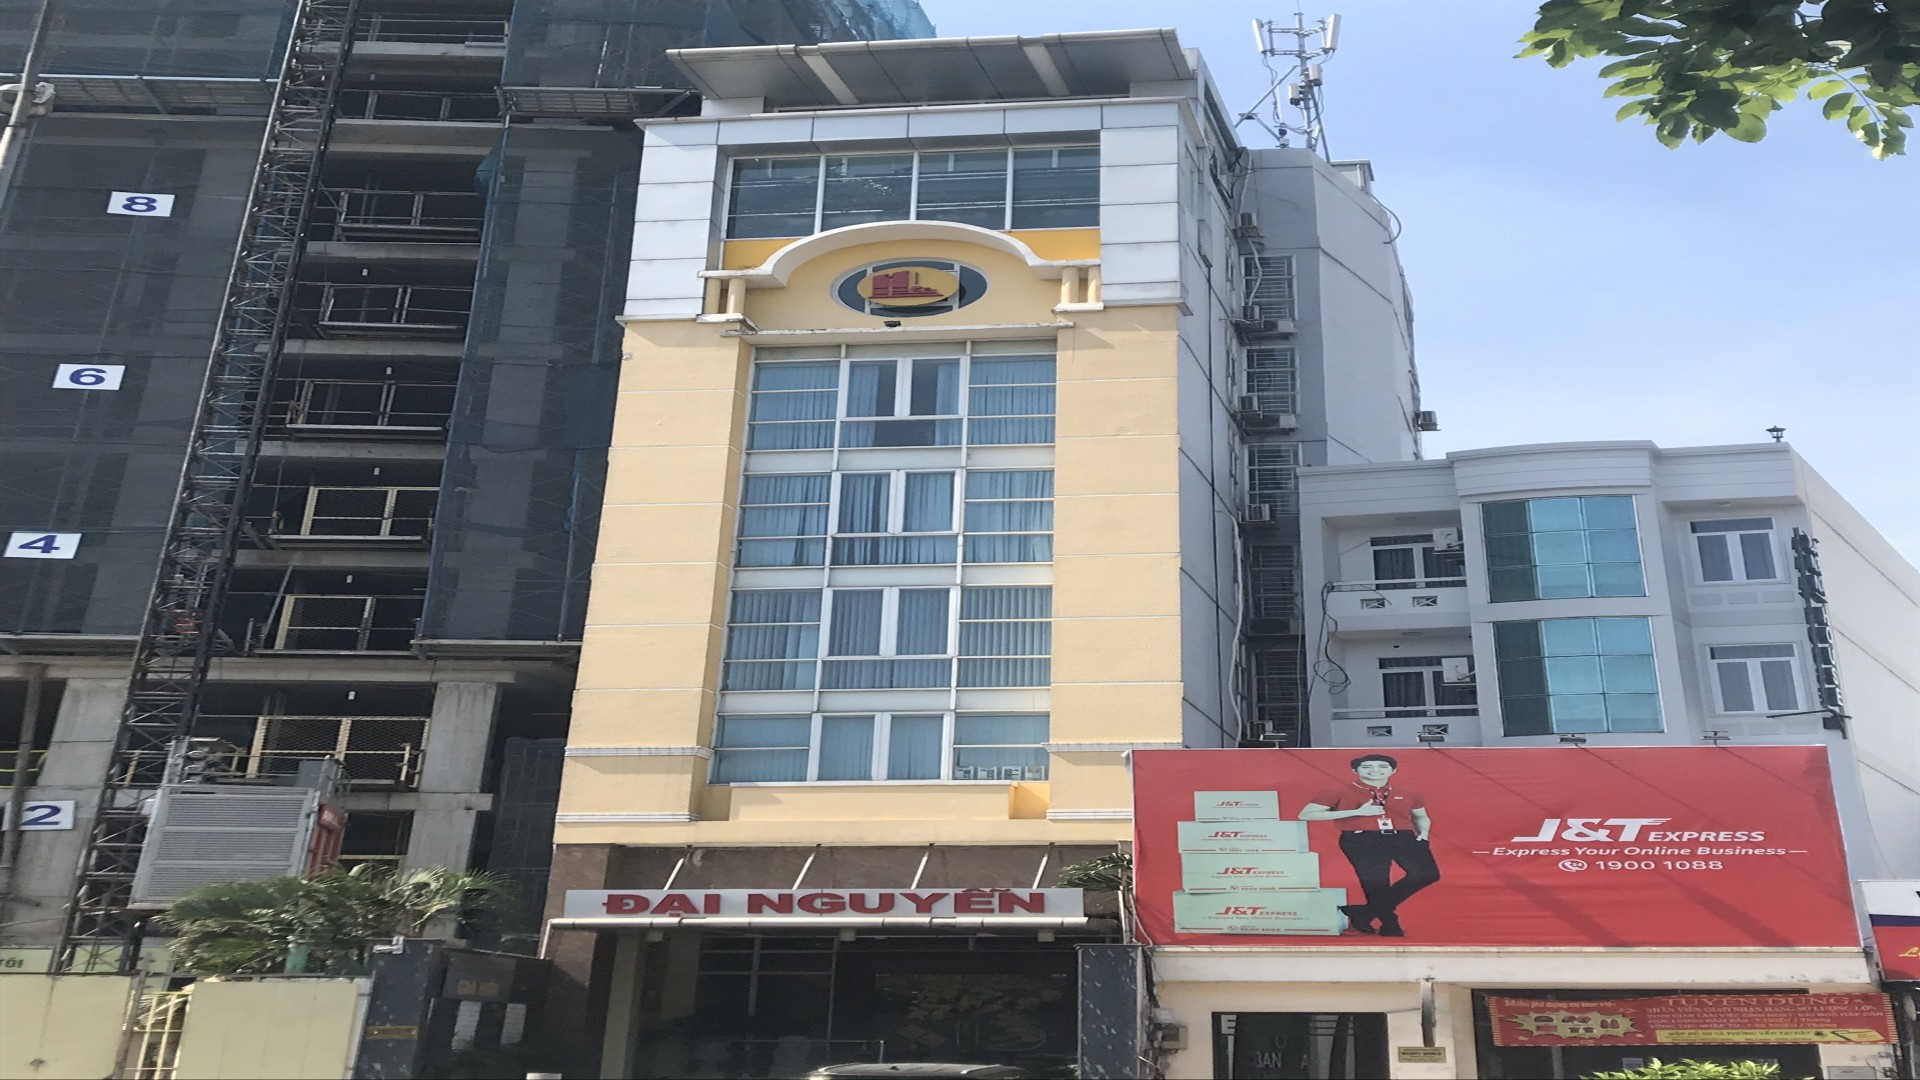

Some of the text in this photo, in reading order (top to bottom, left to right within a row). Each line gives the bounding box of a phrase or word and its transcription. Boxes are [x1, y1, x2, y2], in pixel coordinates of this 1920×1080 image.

[121, 195, 157, 214] 8
[68, 368, 107, 387] 6
[18, 534, 61, 554] 4
[22, 804, 62, 826] 2
[1511, 817, 1765, 842] J&T EXPRESS
[1492, 846, 1786, 858] Express Your Online Business
[1596, 860, 1655, 871] 1900
[1663, 860, 1723, 871] 1088
[603, 888, 1046, 917] ĐẠI NGUYỄN
[1215, 906, 1267, 915] J&T
